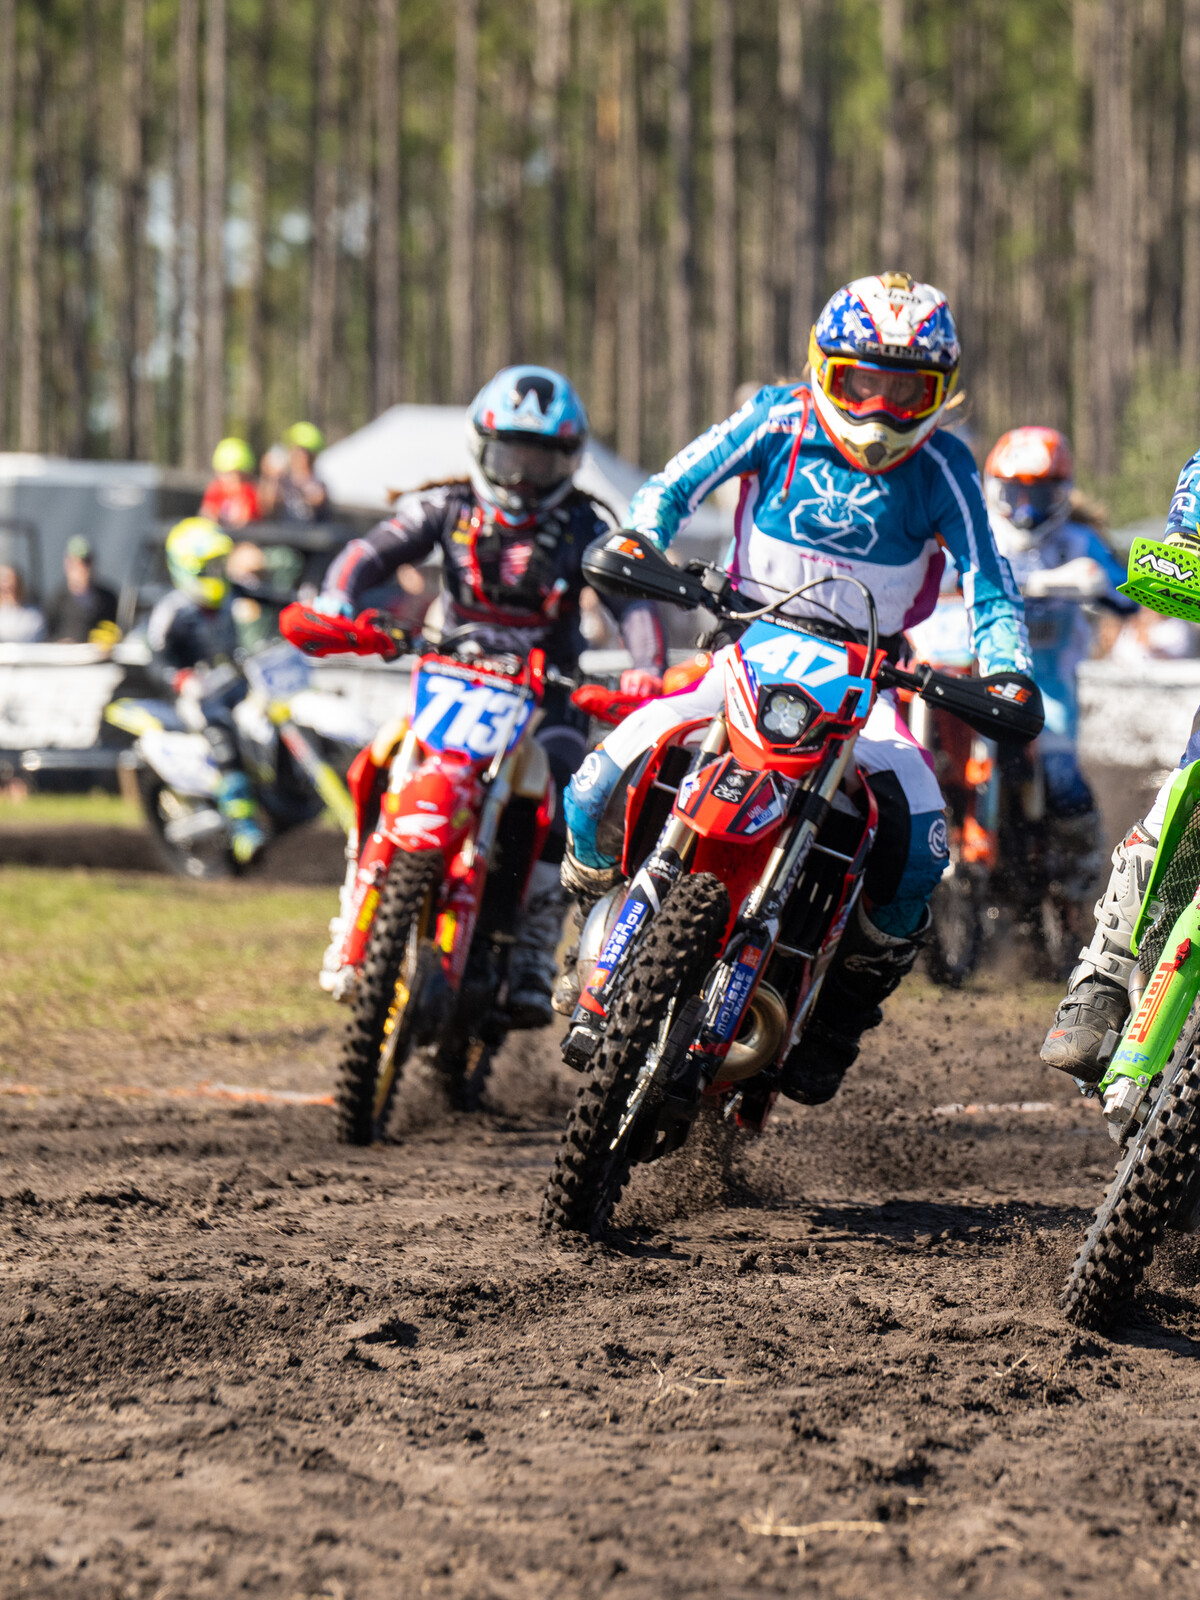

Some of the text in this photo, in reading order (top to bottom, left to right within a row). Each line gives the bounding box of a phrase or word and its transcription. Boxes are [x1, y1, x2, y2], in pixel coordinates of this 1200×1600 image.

[1138, 554, 1194, 581] ASV
[741, 633, 849, 689] 417
[413, 675, 529, 757] 713
[605, 901, 645, 964] MOUSSE
[716, 971, 746, 1036] MOUSSE
[733, 975, 753, 1017] BALLS
[1127, 962, 1178, 1043] PIRELLI
